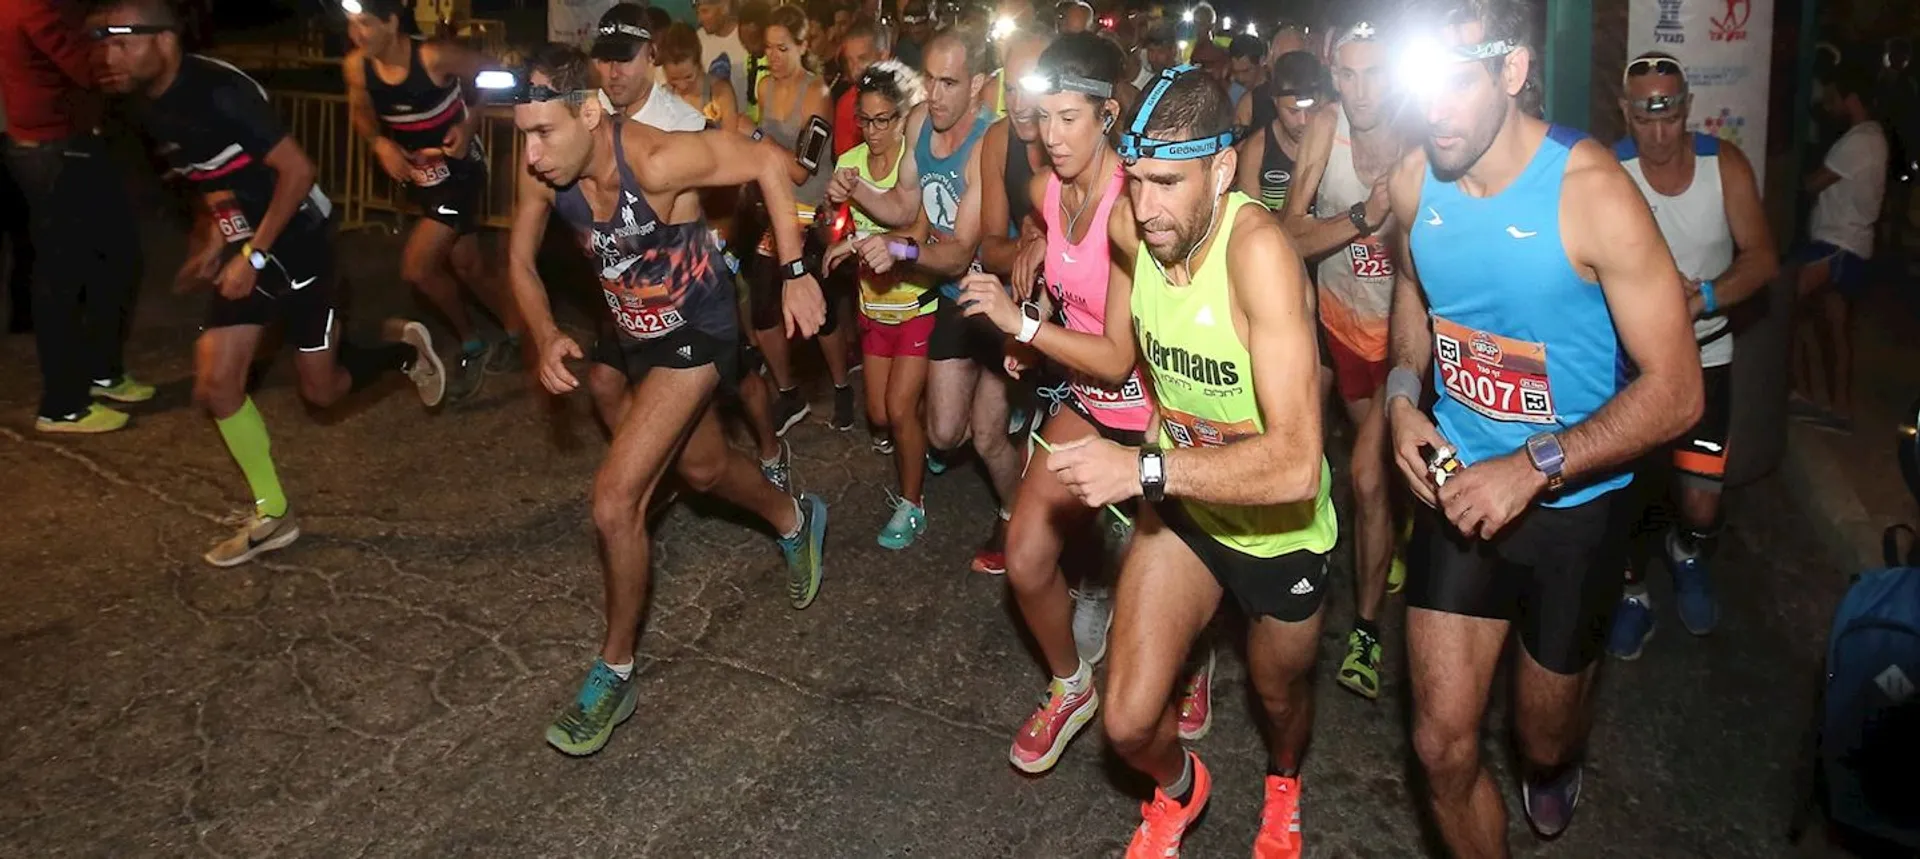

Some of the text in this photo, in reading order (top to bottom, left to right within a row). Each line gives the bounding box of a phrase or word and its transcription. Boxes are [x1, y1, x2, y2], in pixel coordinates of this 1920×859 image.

[612, 308, 662, 332] 2642
[1135, 315, 1240, 387] termans
[1442, 363, 1516, 411] 2007
